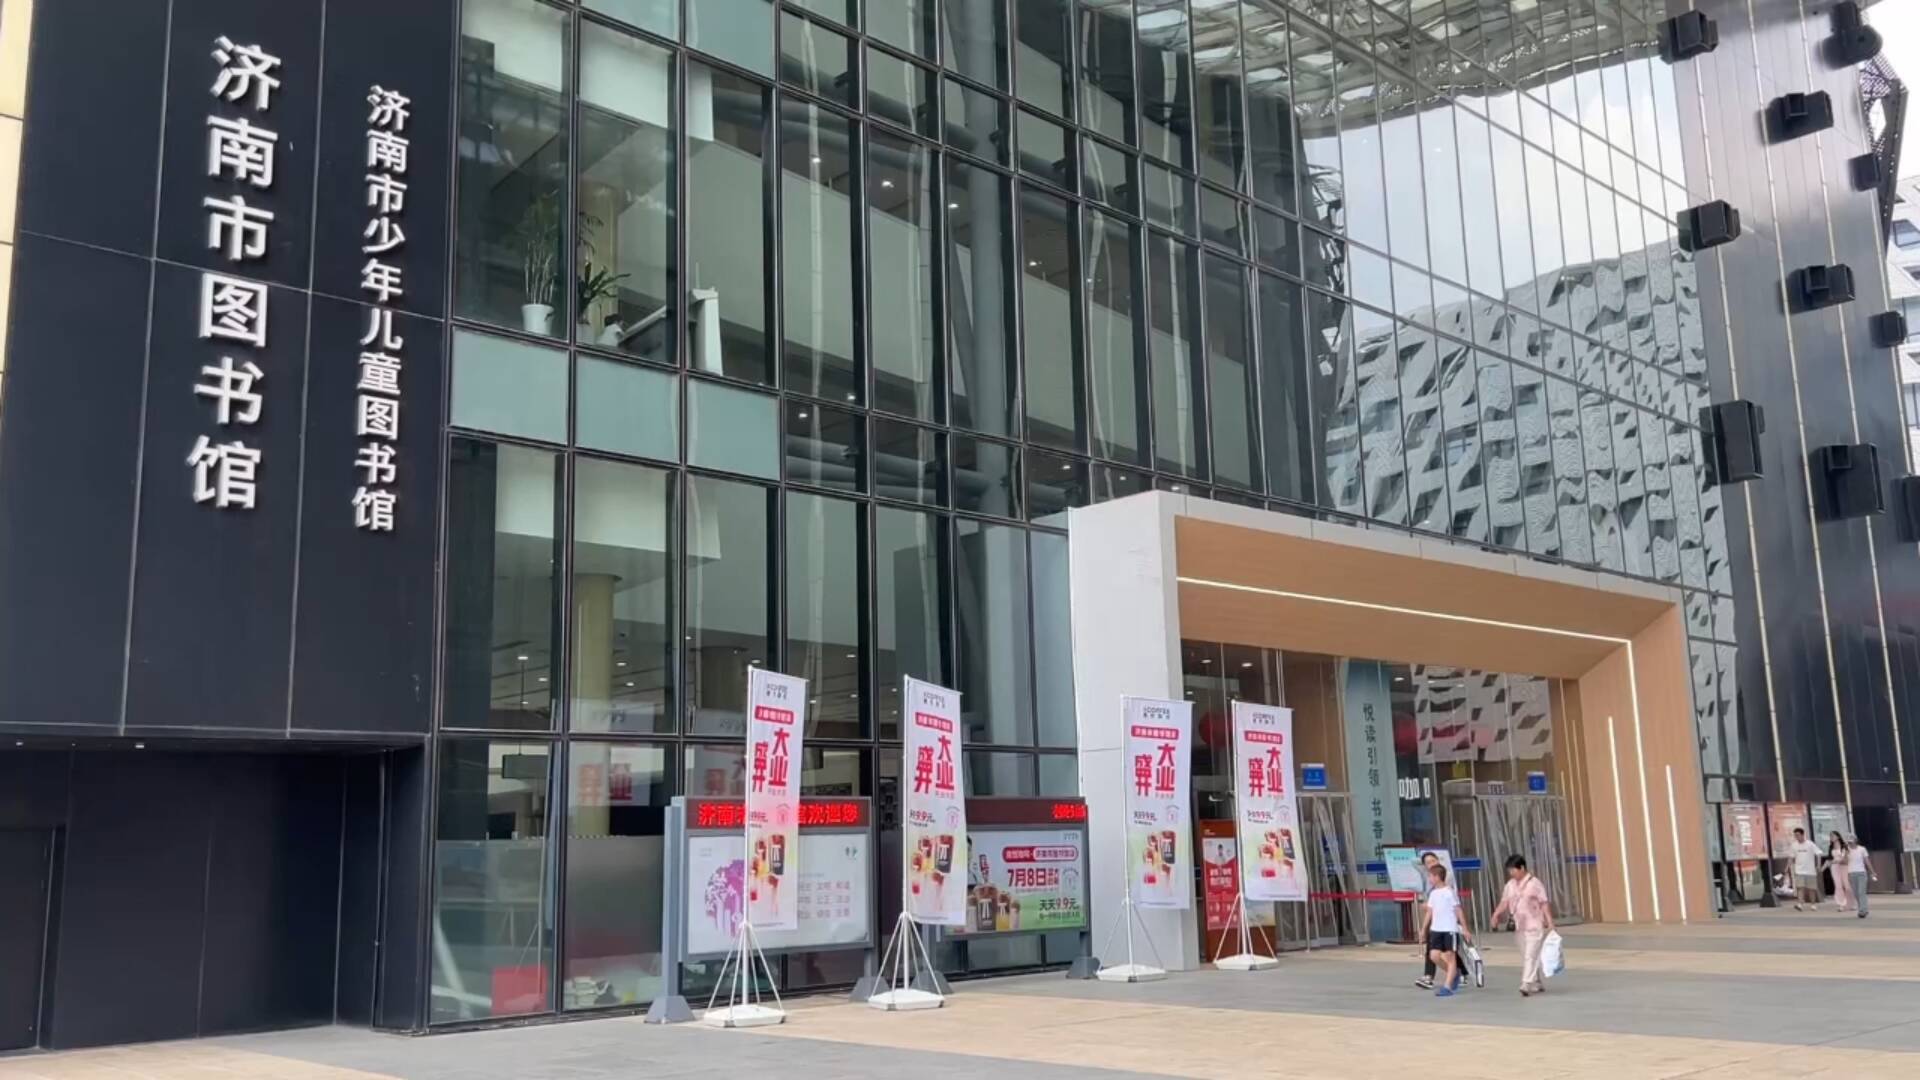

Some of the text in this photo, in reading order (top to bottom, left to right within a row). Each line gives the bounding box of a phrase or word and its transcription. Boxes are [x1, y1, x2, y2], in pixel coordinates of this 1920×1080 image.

[186, 34, 283, 510] 济南市图书馆
[351, 84, 411, 532] 济南市少年儿童图书馆
[1007, 868, 1047, 887] 7月8日
